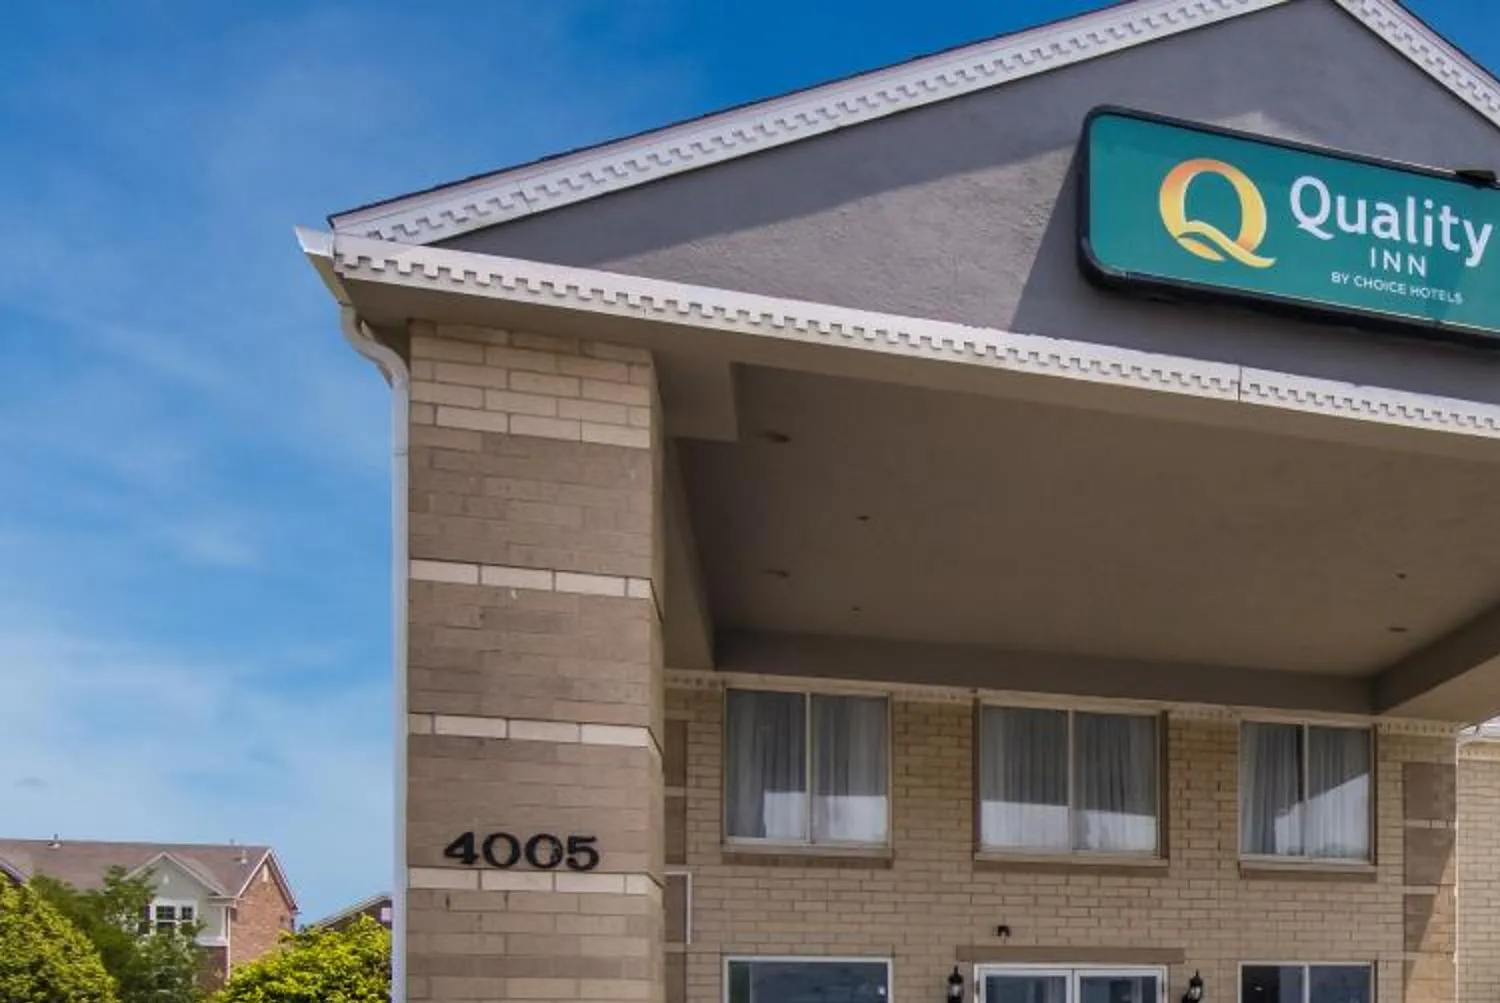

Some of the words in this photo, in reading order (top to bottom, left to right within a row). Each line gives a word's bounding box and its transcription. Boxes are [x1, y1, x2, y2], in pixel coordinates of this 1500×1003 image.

[1159, 158, 1276, 268] Q
[1289, 175, 1493, 267] Quality
[1370, 247, 1427, 277] INN
[1331, 272, 1349, 285] BY
[1353, 275, 1406, 295] CHOICE
[1410, 286, 1462, 304] HOTELS
[443, 831, 599, 871] 4005
